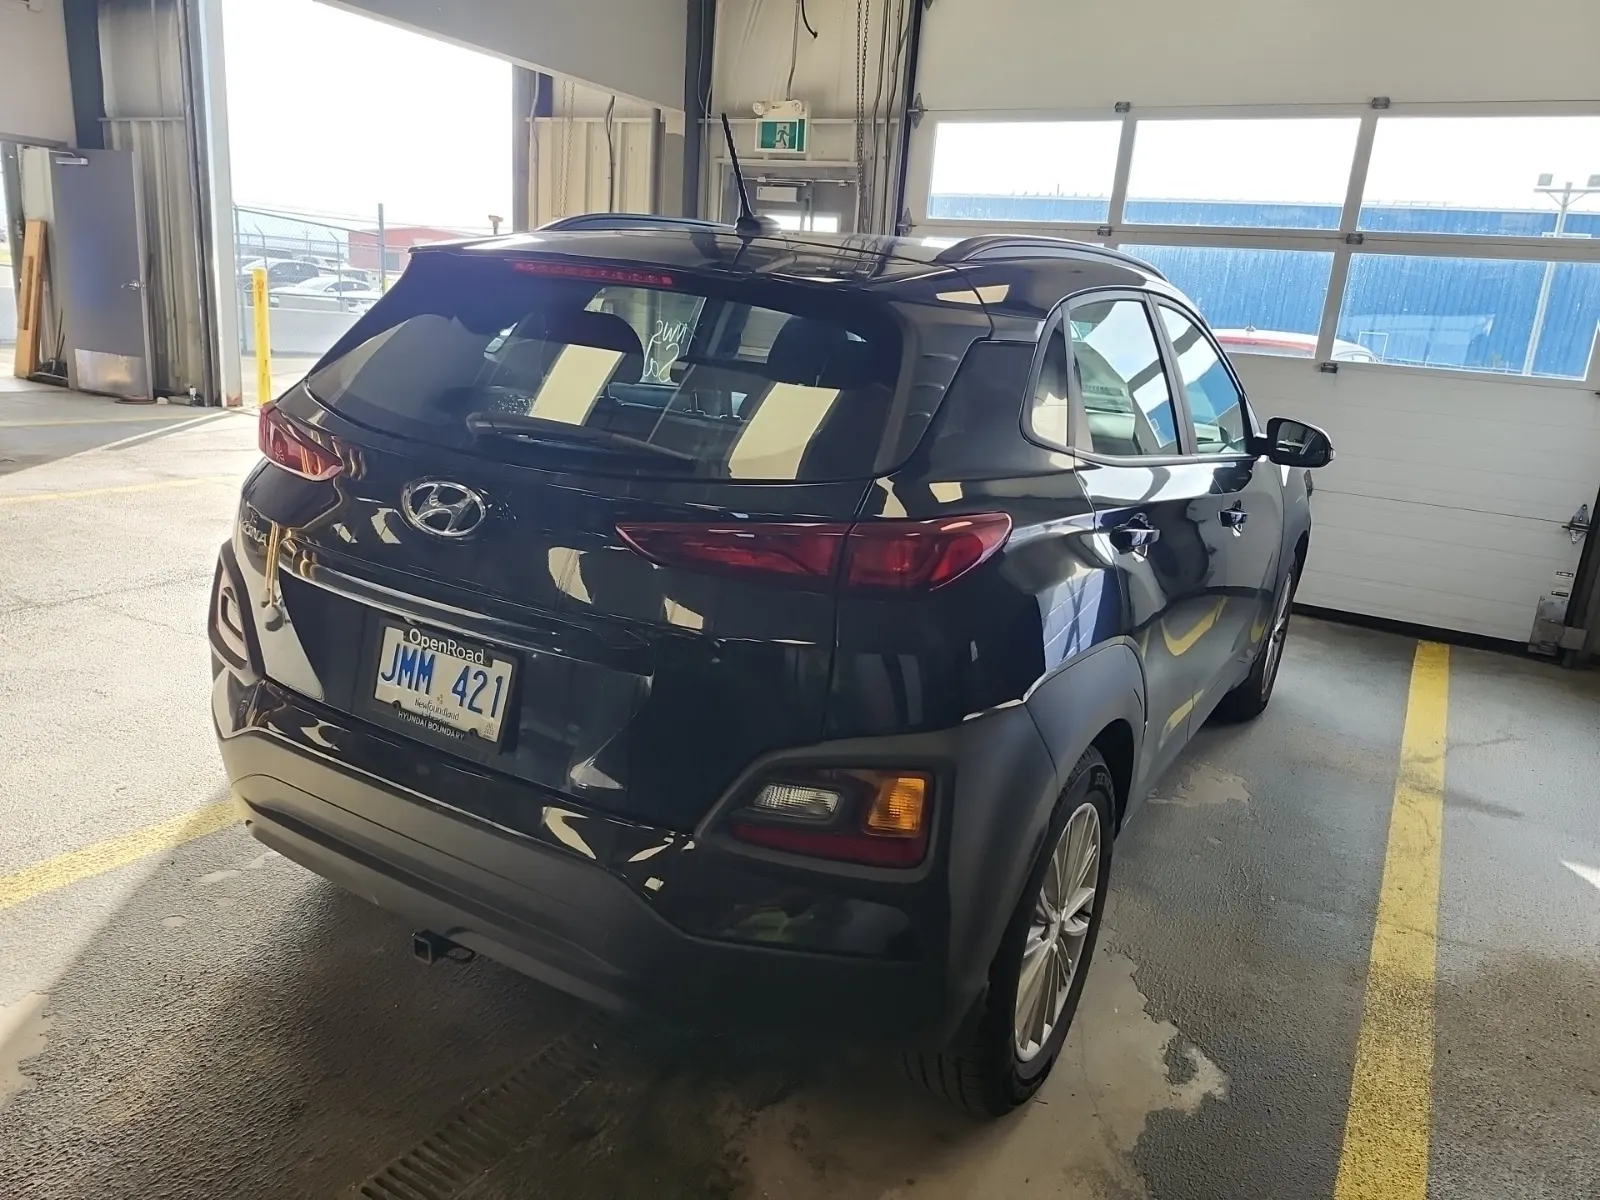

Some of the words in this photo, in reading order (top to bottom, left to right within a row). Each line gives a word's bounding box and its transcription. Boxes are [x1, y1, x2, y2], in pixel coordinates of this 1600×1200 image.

[409, 628, 484, 665] OpenRoad
[381, 643, 435, 695] JMM
[452, 665, 503, 718] 421
[398, 711, 427, 728] HYUNDAI
[428, 720, 465, 740] BOUNDARY
[414, 698, 459, 721] Newfoundland
